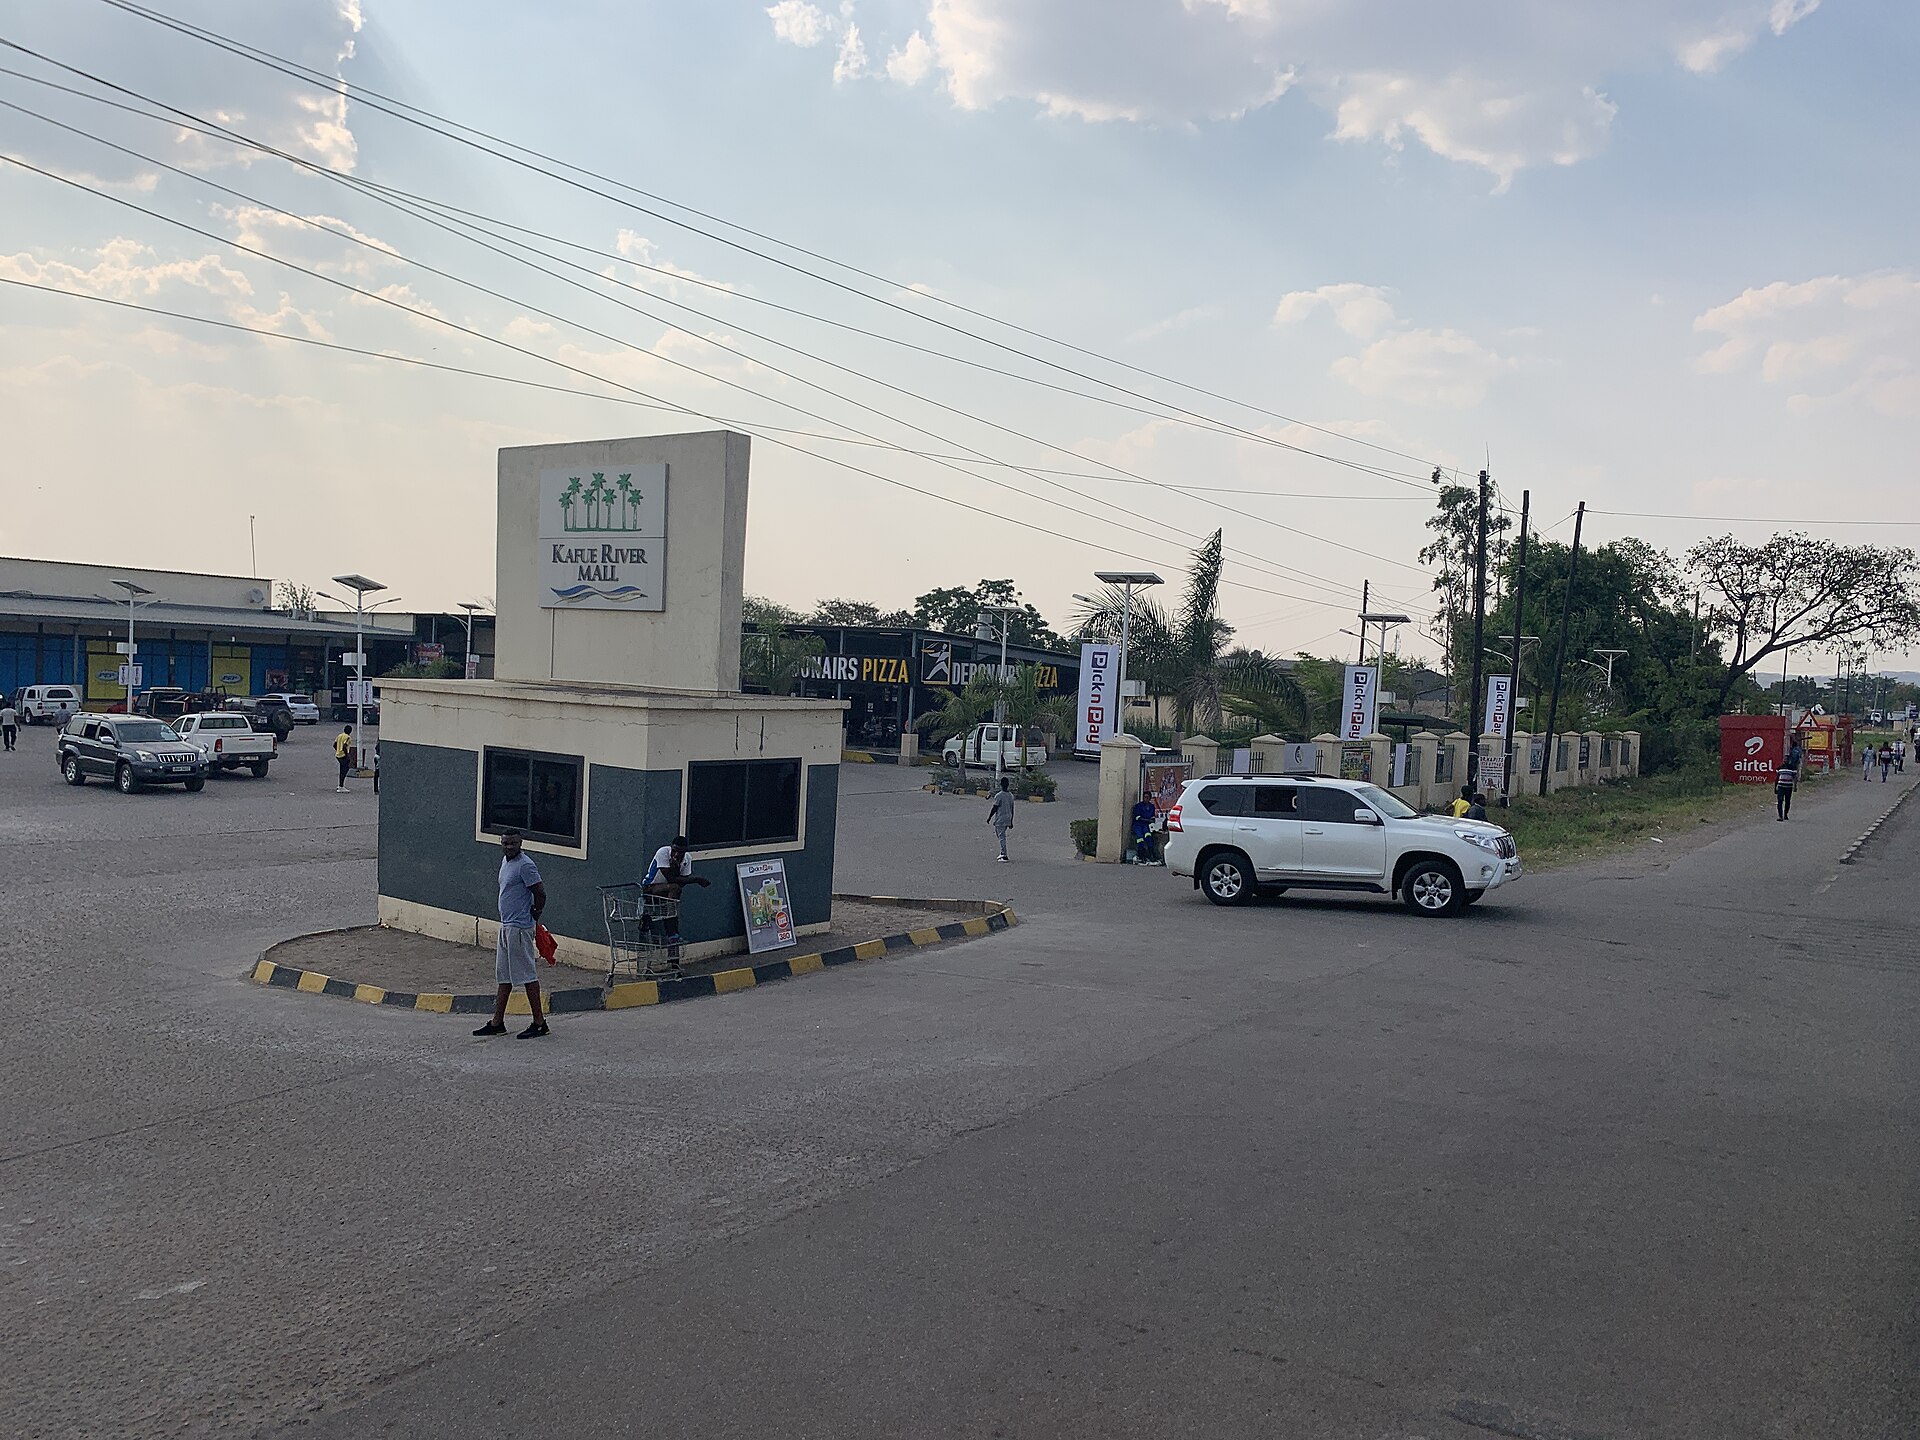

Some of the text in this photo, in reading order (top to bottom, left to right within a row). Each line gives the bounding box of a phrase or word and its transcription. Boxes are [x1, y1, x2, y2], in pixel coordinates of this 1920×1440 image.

[552, 544, 648, 564] KAFUE RIVER
[578, 565, 619, 582] MALL
[862, 658, 909, 683] PIZZA
[1354, 672, 1368, 701] Pick
[1495, 680, 1508, 704] Pick
[1085, 651, 1109, 745] Pick n Pay
[1353, 702, 1363, 710] n
[1349, 712, 1365, 739] Pay
[1734, 758, 1774, 772] airtel
[1739, 775, 1768, 783] money
